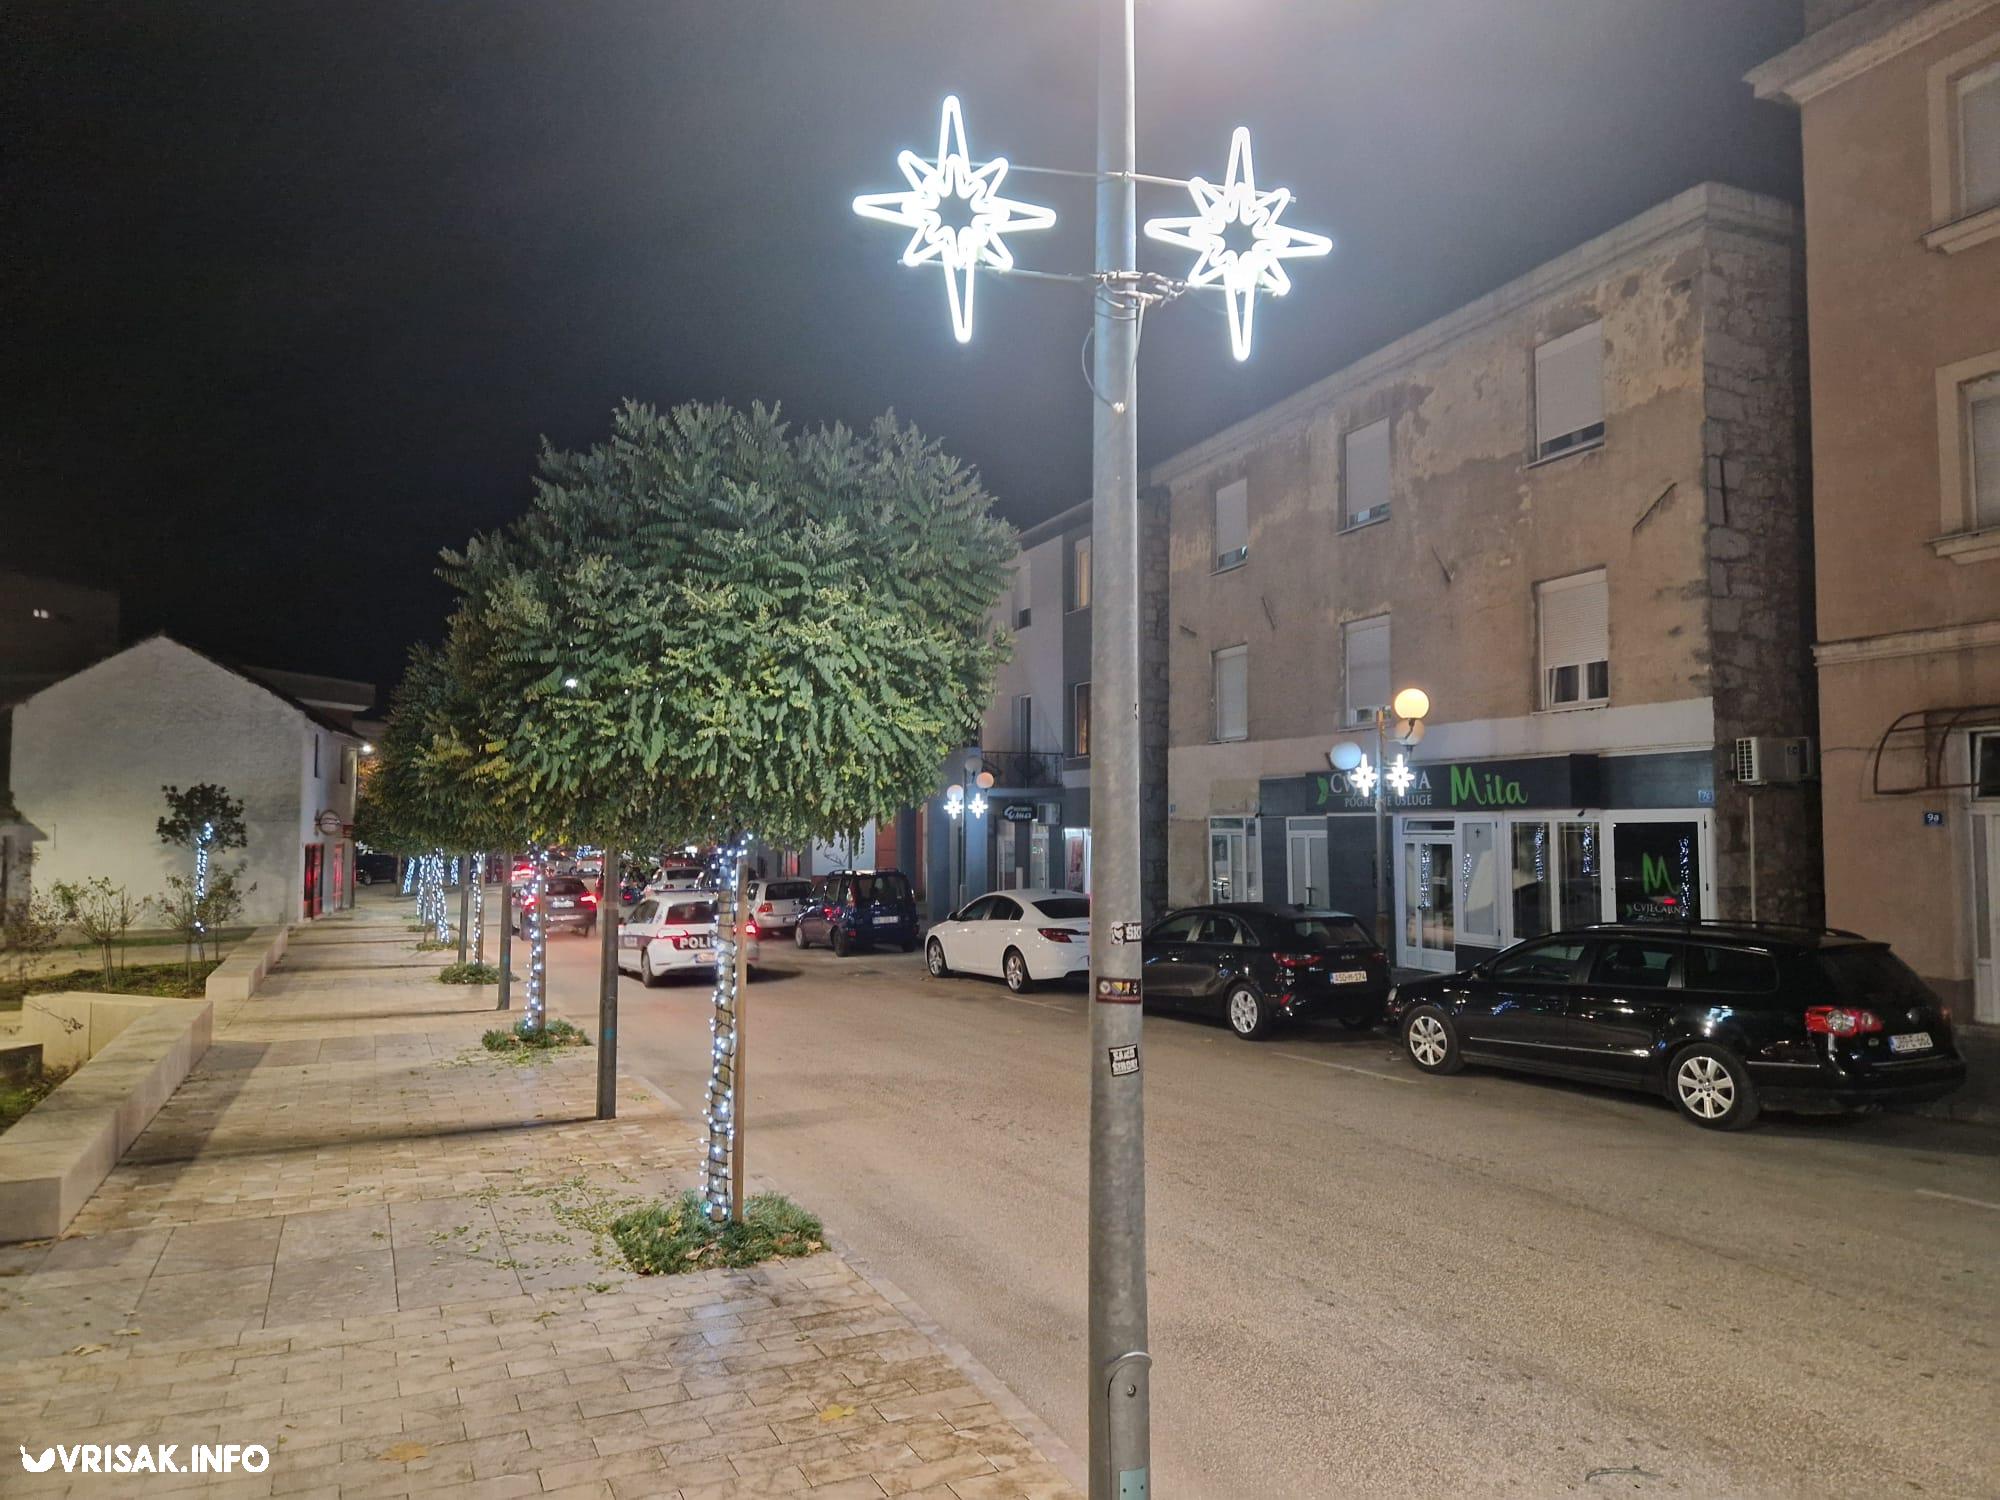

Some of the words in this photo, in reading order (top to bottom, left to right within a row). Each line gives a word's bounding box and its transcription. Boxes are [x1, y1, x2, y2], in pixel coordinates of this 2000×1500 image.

[1450, 765, 1528, 806] Mila
[1345, 796, 1392, 808] POGRENE
[1395, 795, 1432, 806] USLUGE
[1643, 853, 1681, 895] M
[680, 936, 716, 950] POLI
